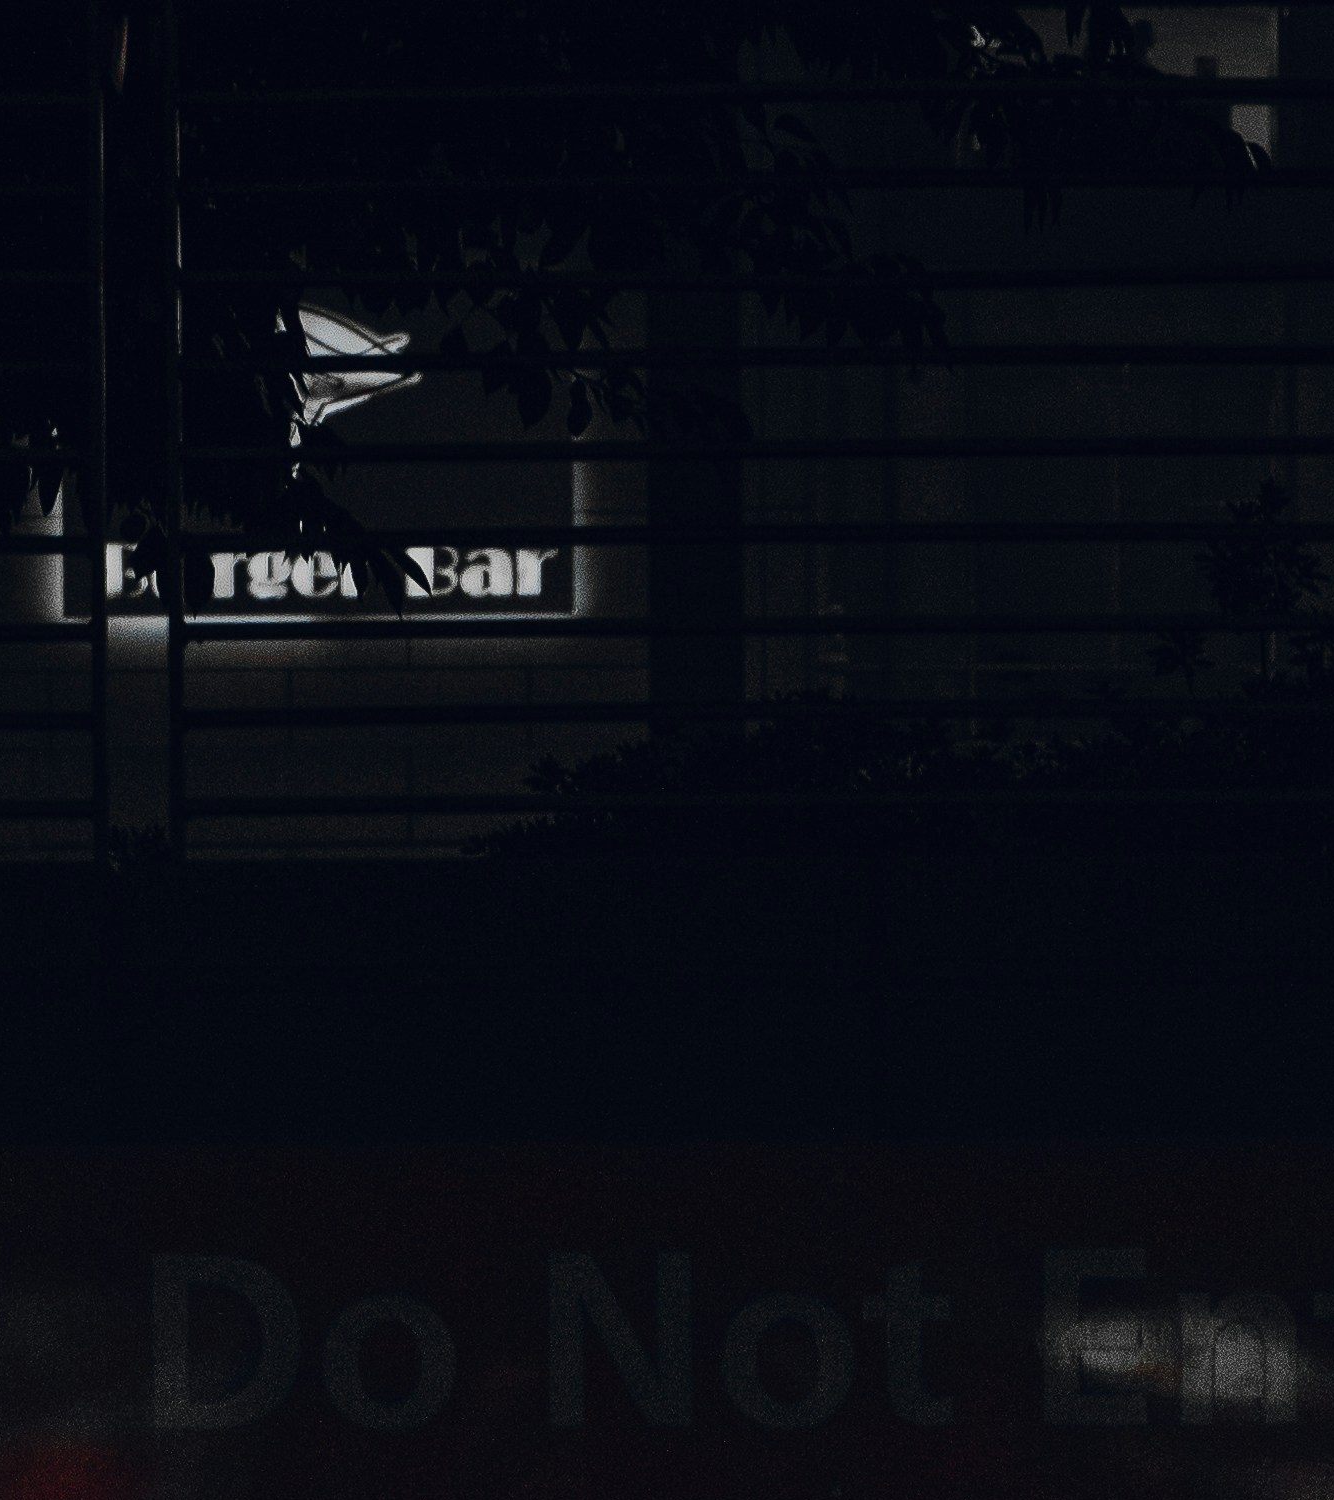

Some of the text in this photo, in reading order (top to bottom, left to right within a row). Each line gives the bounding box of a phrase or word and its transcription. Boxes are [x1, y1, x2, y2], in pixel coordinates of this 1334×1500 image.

[405, 545, 561, 599] Bar
[152, 1251, 458, 1431] Do
[548, 1250, 954, 1431] Not
